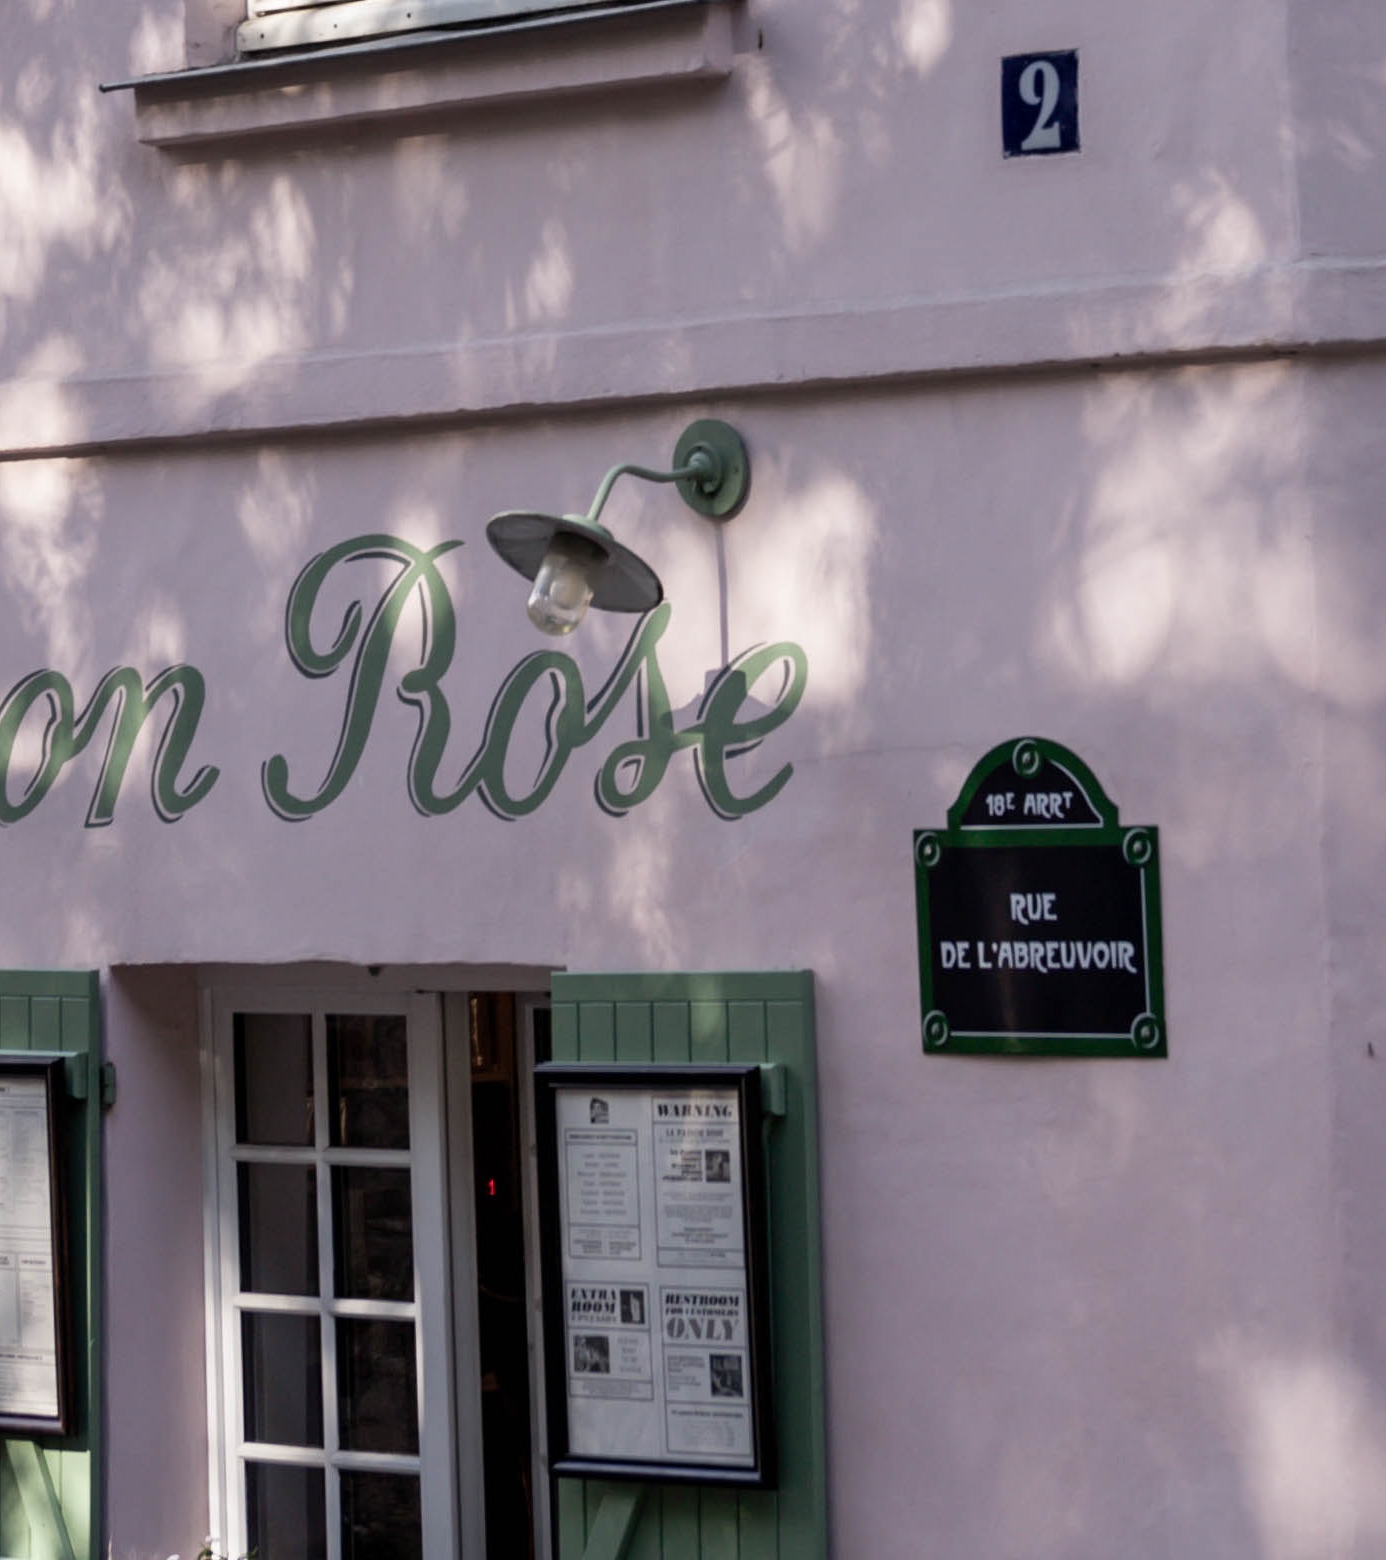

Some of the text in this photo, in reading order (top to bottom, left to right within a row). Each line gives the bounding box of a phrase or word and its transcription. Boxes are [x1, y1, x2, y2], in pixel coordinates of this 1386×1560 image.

[1019, 60, 1061, 151] 2
[263, 532, 811, 823] Rose
[1009, 892, 1058, 925] RUE
[940, 941, 1138, 973] DE L'ABREUVOIR
[657, 1103, 733, 1118] WARNING
[571, 1288, 616, 1300] EXTRA
[665, 1293, 739, 1307] RESTROOM
[571, 1300, 617, 1313] ROOM
[666, 1317, 739, 1341] ONLY
